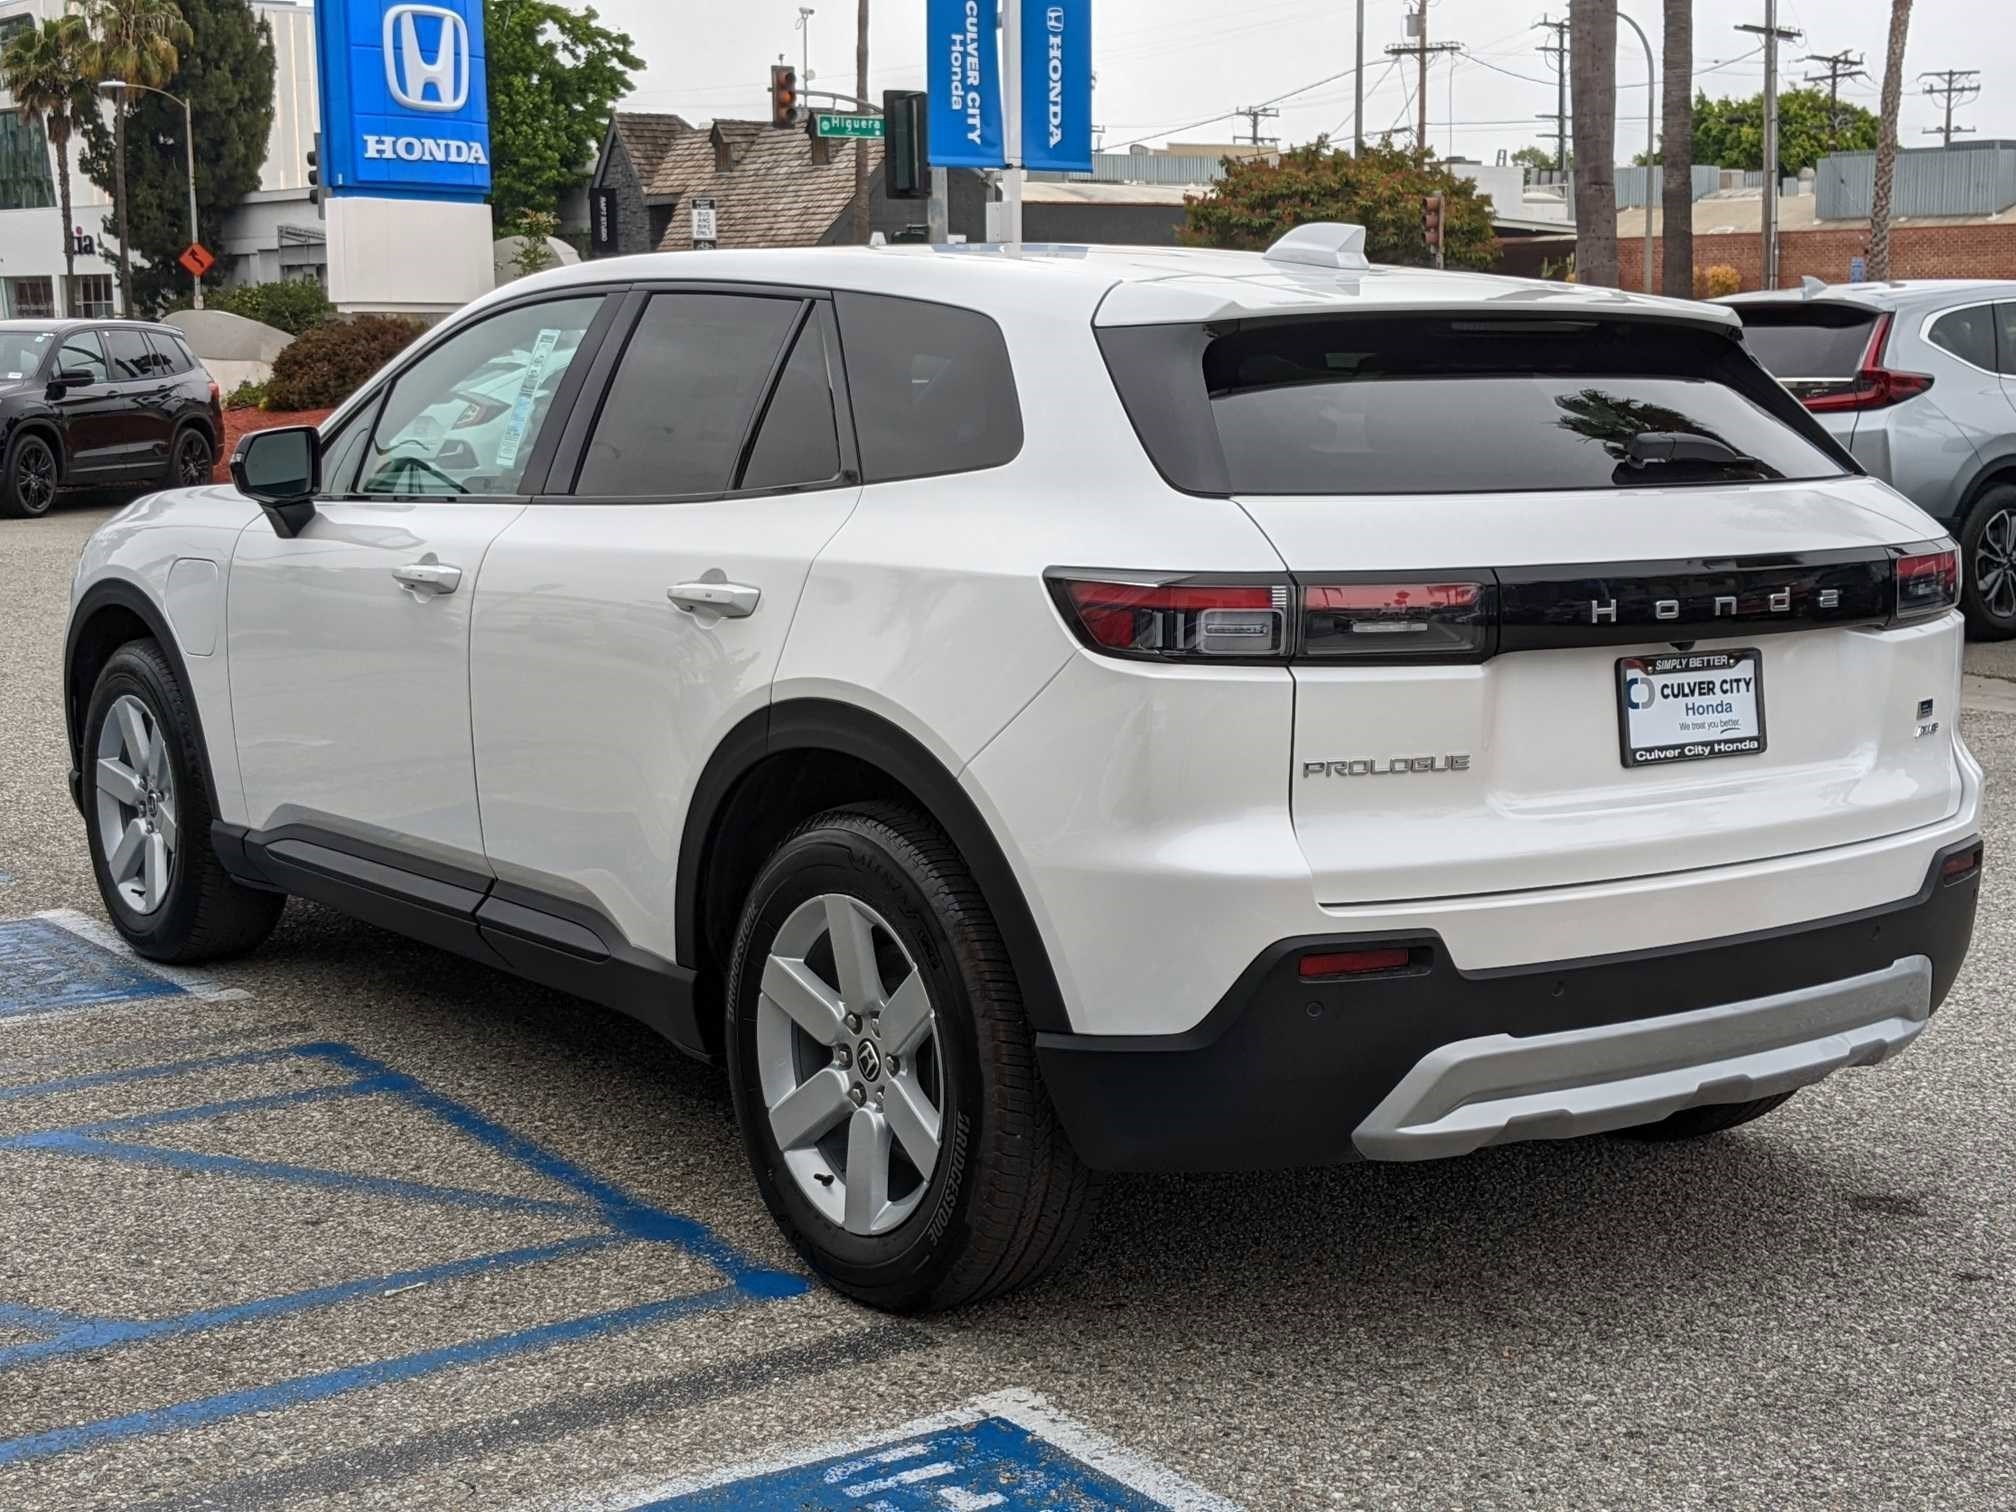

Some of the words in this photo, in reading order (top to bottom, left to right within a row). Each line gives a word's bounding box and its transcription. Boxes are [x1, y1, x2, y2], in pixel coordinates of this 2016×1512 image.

[966, 0, 980, 86] CULVER
[951, 34, 964, 110] Honda
[1048, 35, 1062, 149] HONDA
[831, 116, 881, 131] Higuera
[967, 92, 981, 144] CITY
[363, 135, 489, 165] HONDA
[1591, 586, 1840, 624] Honda
[1655, 659, 1688, 670] SIMPLY
[1689, 655, 1728, 667] BETTER
[1661, 680, 1716, 699] CULVER
[1720, 677, 1752, 695] CITY
[1685, 700, 1733, 716] Honda
[1679, 721, 1690, 730] We
[1707, 721, 1719, 731] you
[1636, 748, 1681, 761] Culver
[1685, 744, 1711, 756] City
[1714, 740, 1758, 751] Honda
[1303, 755, 1470, 778] PROLOGUE
[928, 1111, 971, 1246] BRIDGESTONE
